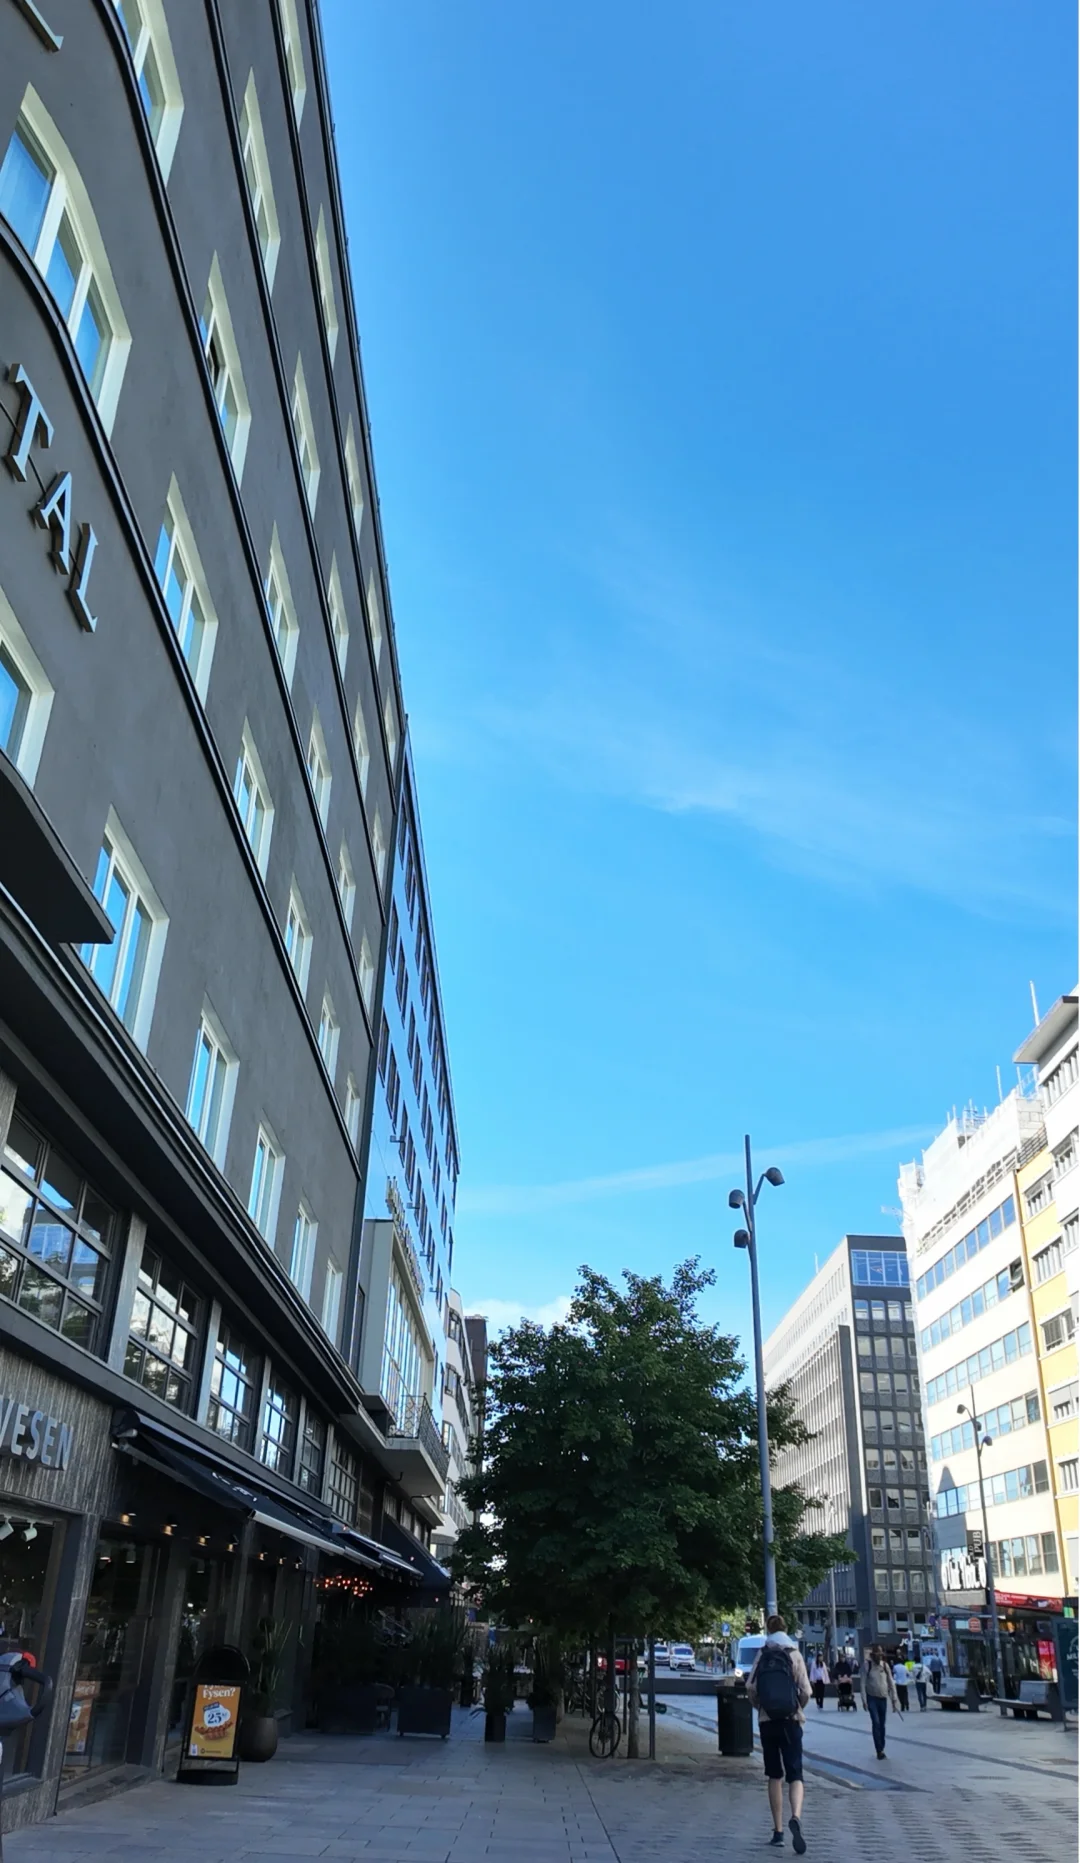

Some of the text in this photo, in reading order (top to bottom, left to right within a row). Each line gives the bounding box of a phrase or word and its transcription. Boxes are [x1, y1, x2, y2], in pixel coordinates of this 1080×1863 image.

[973, 1531, 982, 1553] PUB
[203, 1687, 236, 1700] Fysen?
[207, 1712, 222, 1724] 25
